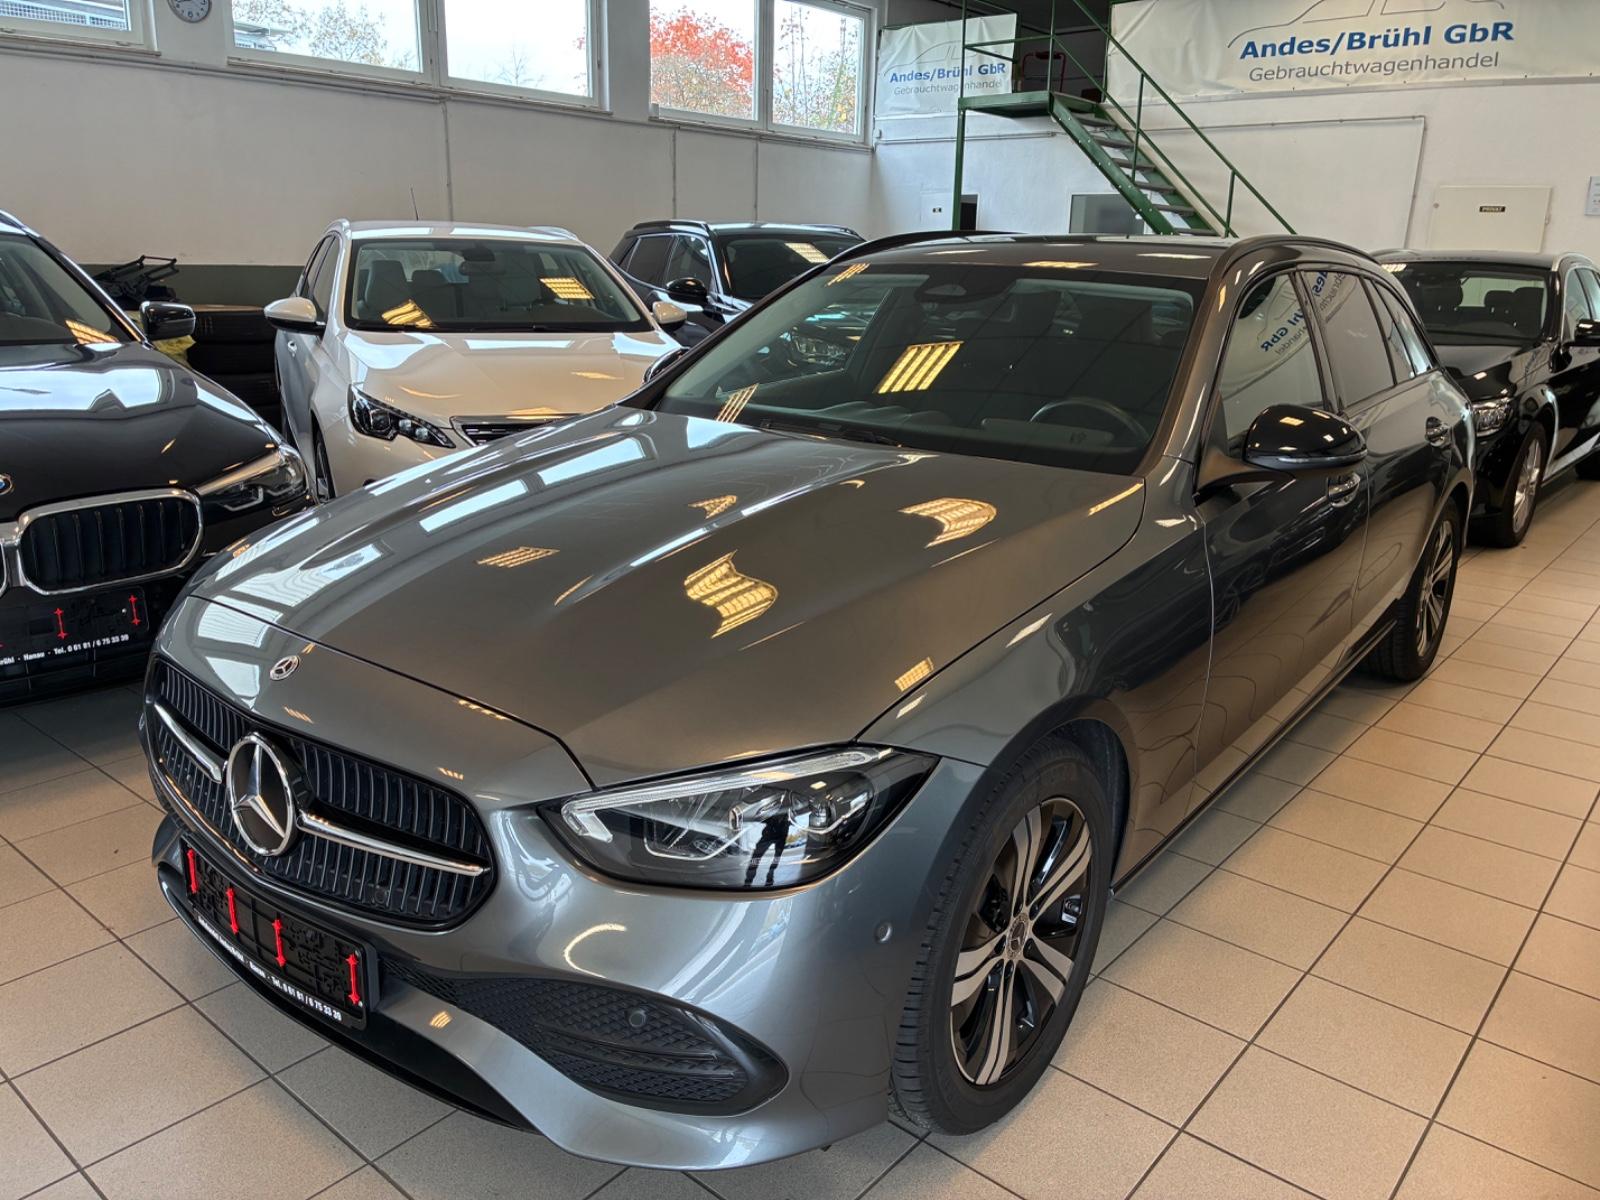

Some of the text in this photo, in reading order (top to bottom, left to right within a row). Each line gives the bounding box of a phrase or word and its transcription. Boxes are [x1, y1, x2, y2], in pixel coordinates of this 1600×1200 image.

[1240, 21, 1515, 59] Andes/Brühl GbR
[978, 63, 1006, 75] GbR
[1249, 52, 1499, 82] Gebrauchtwagenhandel
[894, 79, 1002, 96] Gebrauchtwagnhandel
[53, 647, 67, 655] Tel.
[271, 976, 283, 989] Tel.
